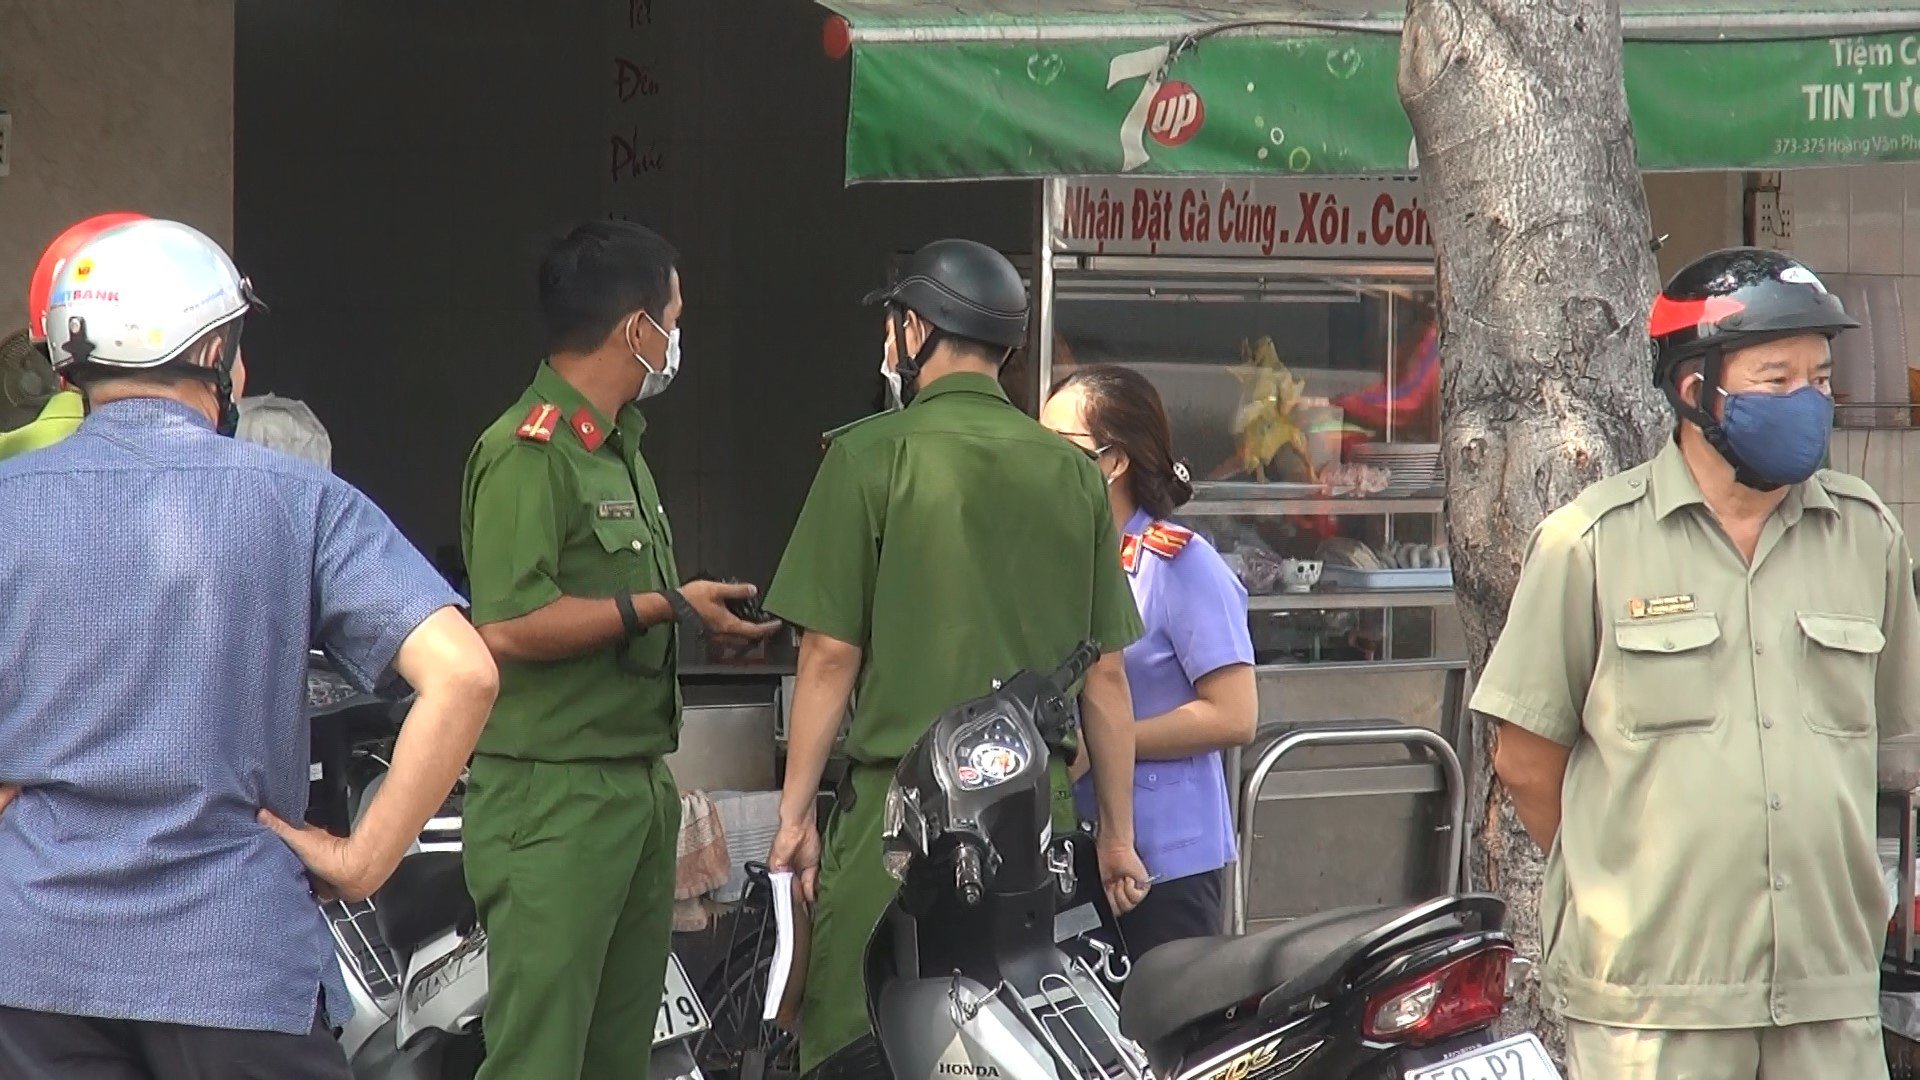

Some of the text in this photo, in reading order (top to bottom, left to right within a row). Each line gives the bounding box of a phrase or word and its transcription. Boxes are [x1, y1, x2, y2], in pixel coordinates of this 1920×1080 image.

[1828, 36, 1893, 75] Tiệm
[1802, 82, 1855, 121] TIN
[1774, 137, 1826, 154] 373-375
[1827, 134, 1870, 156] Hoàng
[1063, 186, 1124, 254] Nhận
[1131, 188, 1173, 254] Đặt
[1179, 188, 1210, 243] Gà
[939, 1062, 1000, 1078] HONDA
